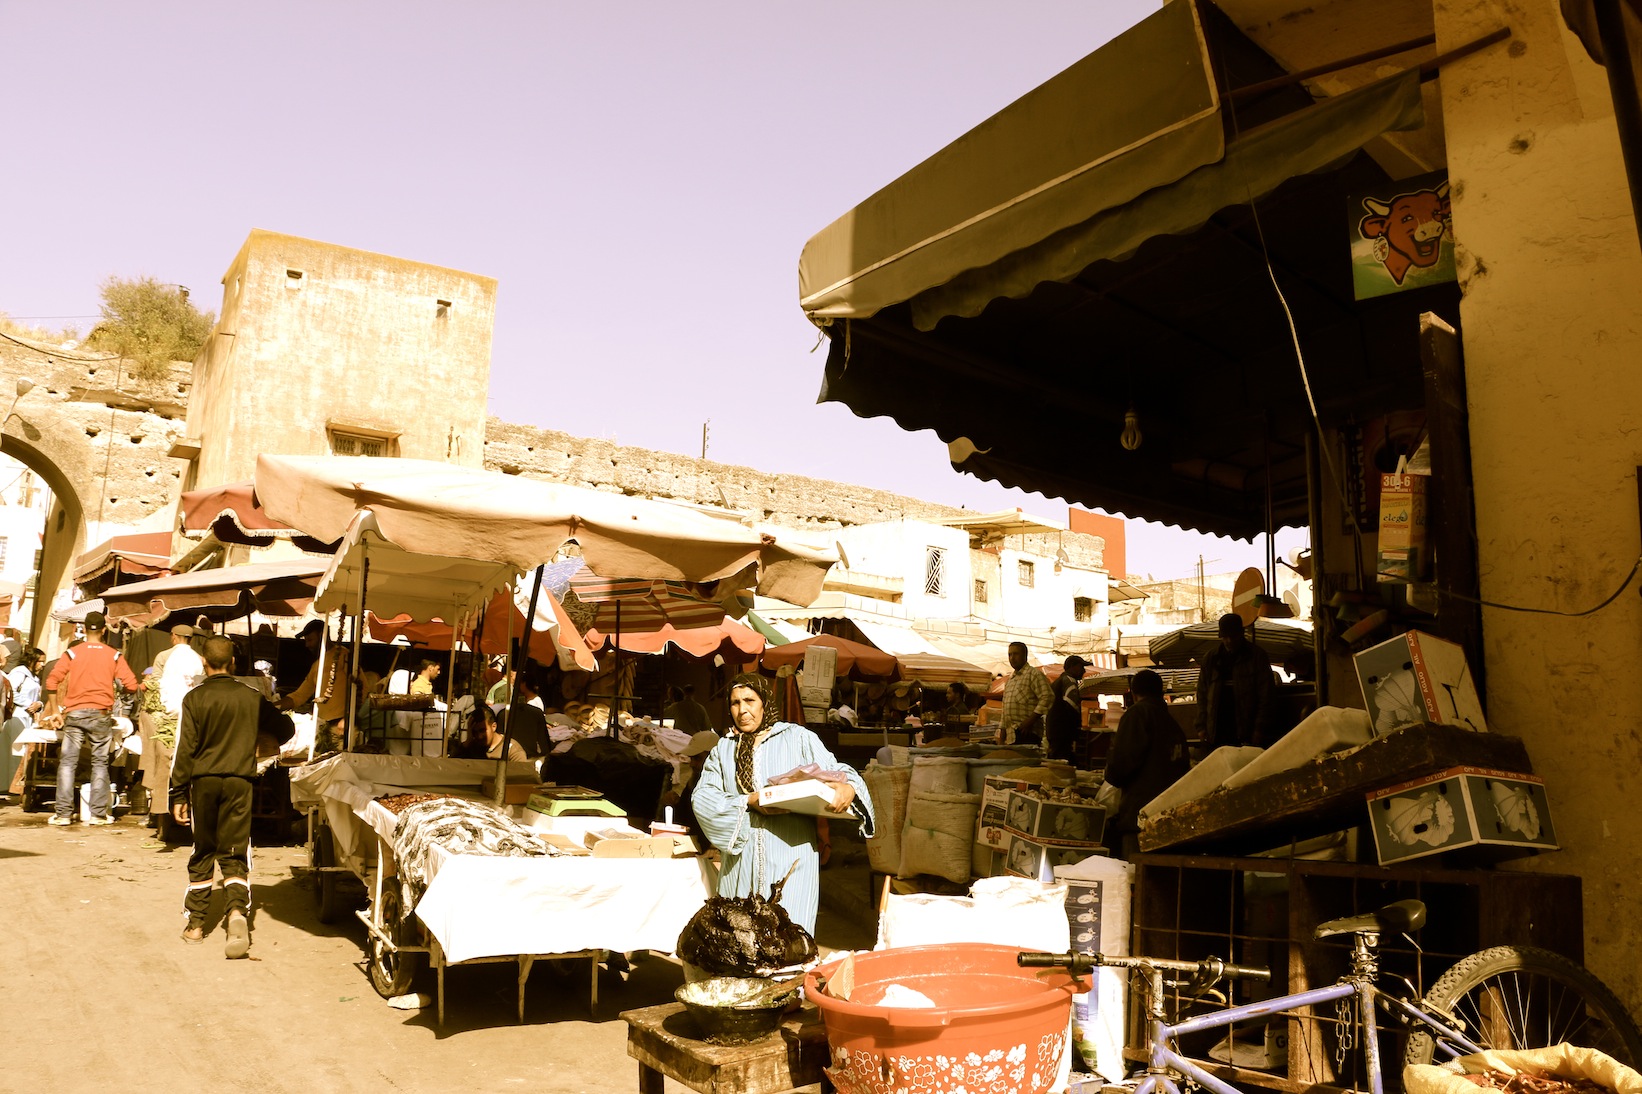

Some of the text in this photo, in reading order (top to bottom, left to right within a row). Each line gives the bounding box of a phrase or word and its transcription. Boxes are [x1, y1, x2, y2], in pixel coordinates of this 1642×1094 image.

[1413, 653, 1421, 665] AIL
[1418, 671, 1428, 693] AGLIO
[1426, 698, 1434, 713] AJO
[1376, 770, 1448, 796] AGLIO AIL AJO
